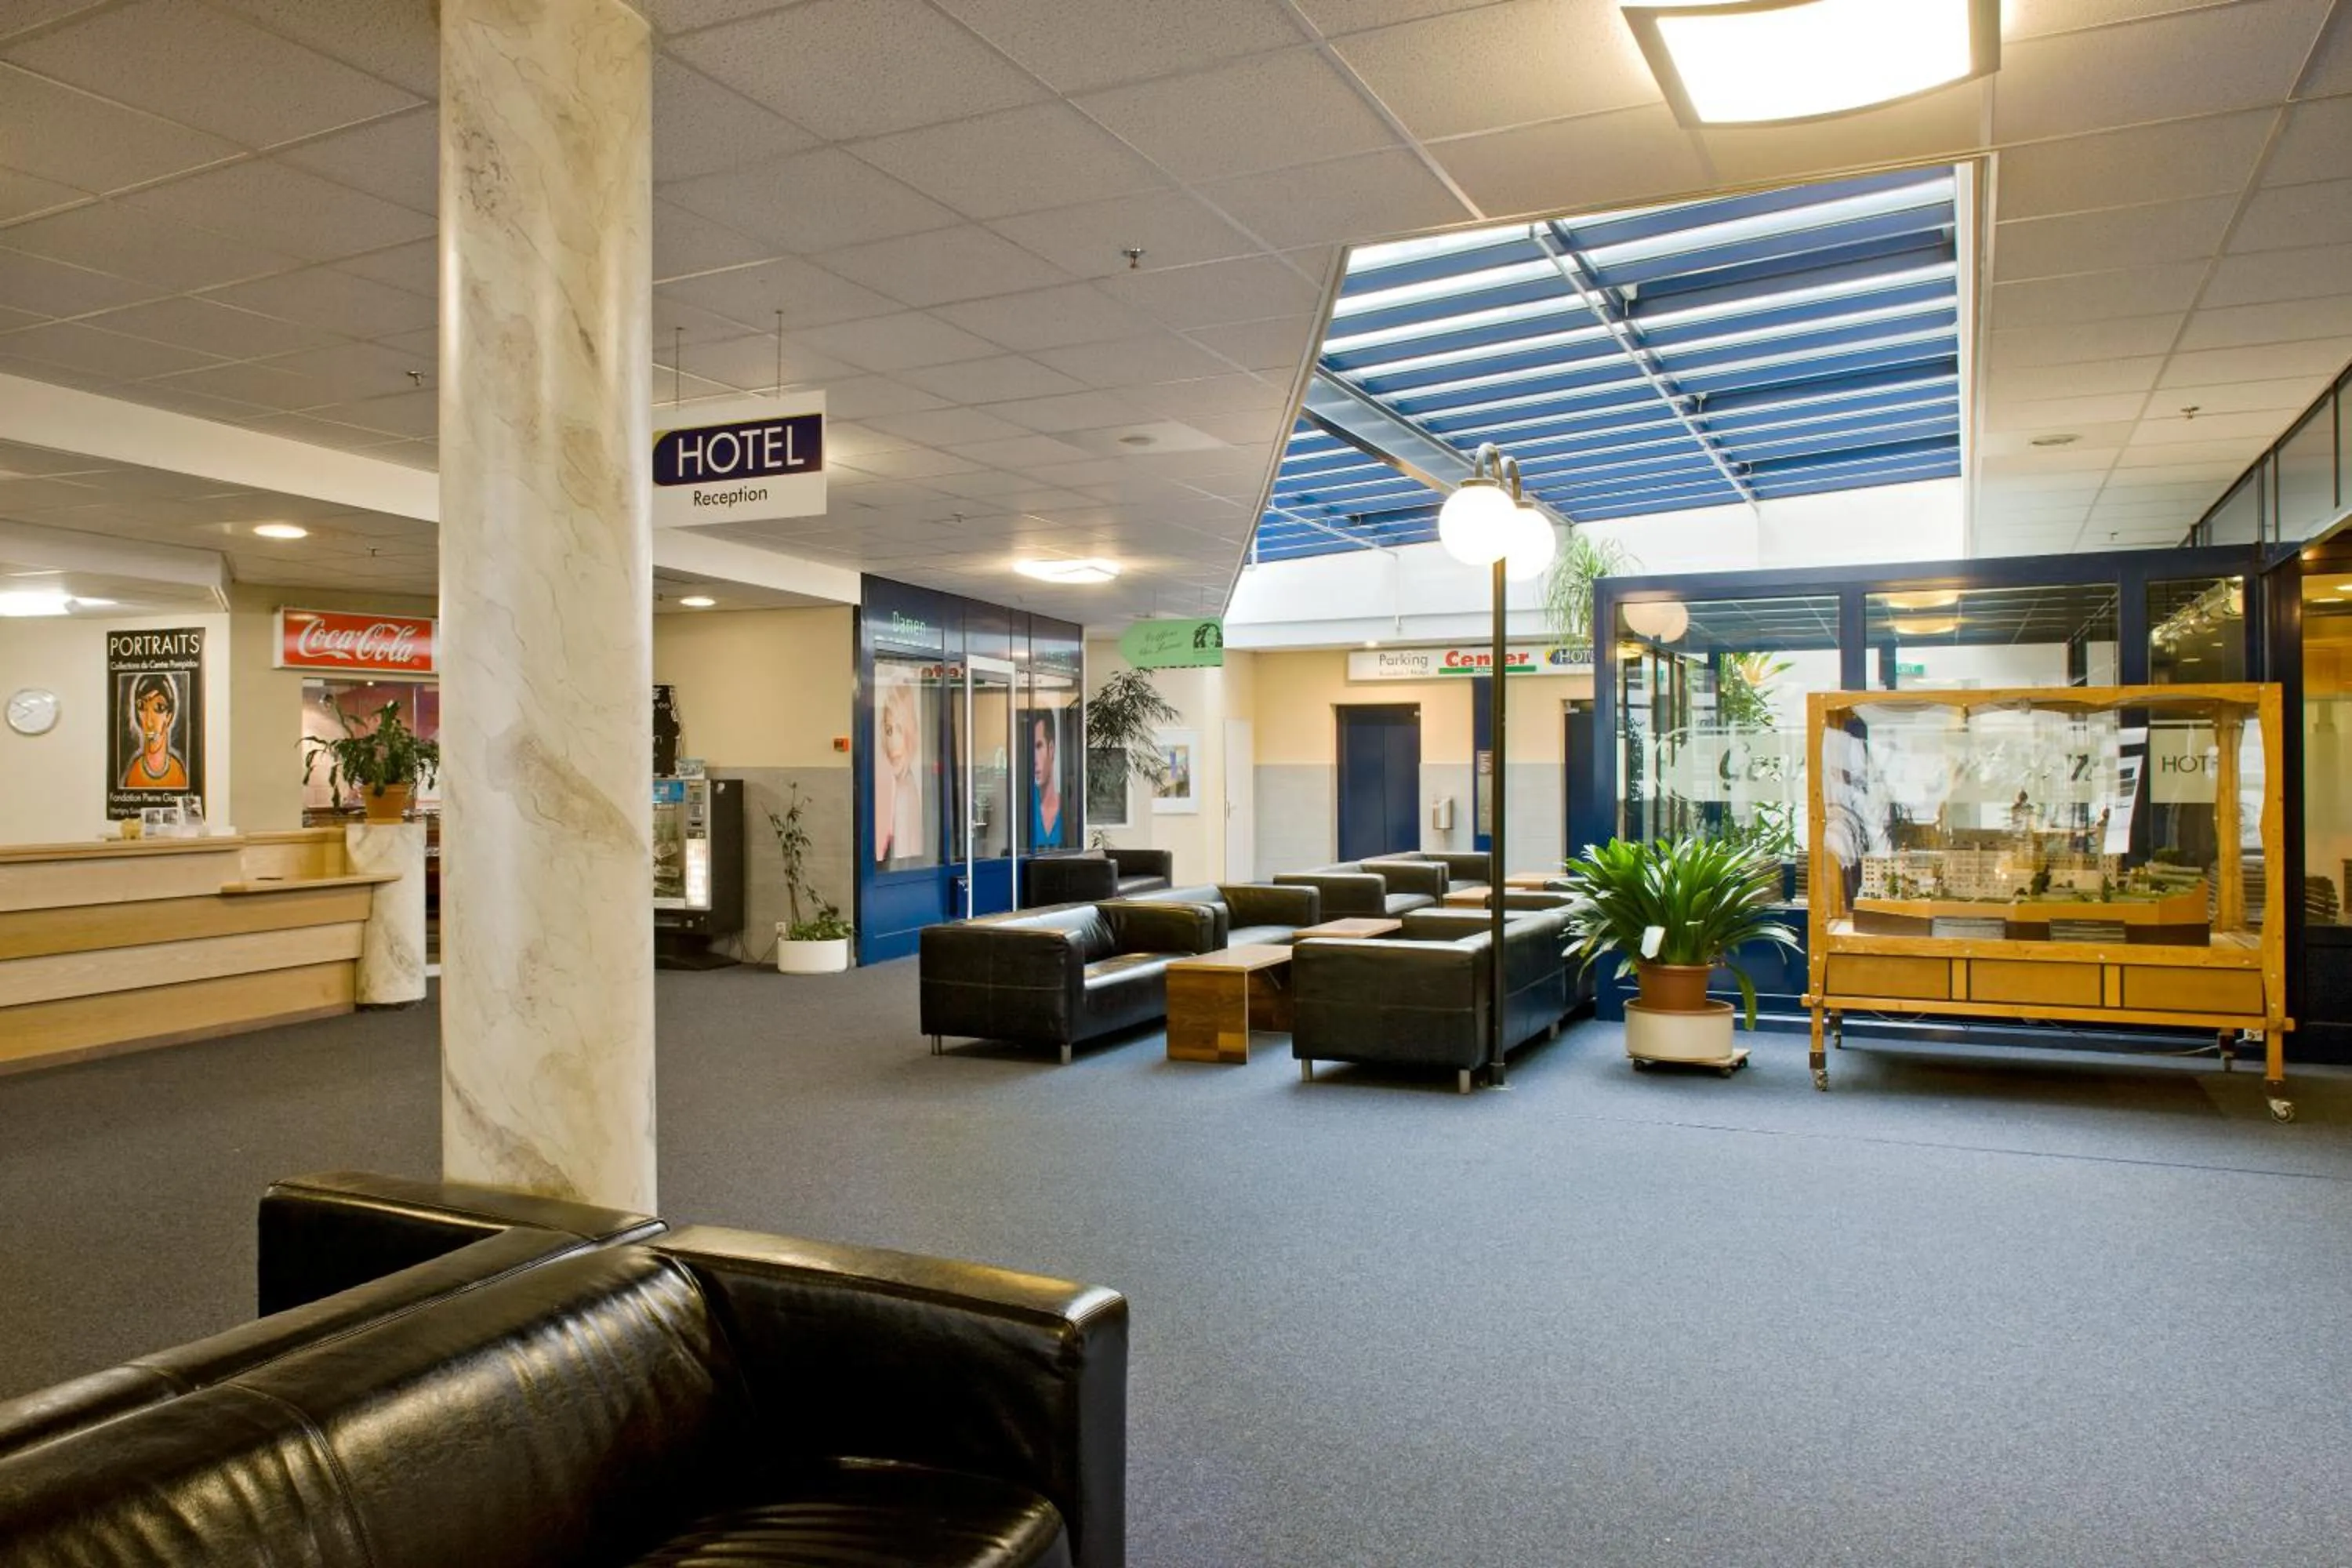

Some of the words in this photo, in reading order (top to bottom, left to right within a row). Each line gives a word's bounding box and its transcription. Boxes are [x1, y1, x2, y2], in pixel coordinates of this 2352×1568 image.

[677, 424, 805, 477] HOTEL
[693, 486, 768, 508] Reception
[110, 634, 201, 656] PORTRAITS
[297, 617, 419, 663] Coca-Cola
[1378, 652, 1428, 669] Parking
[1445, 650, 1530, 666] Cener
[2161, 754, 2219, 774] HOT
